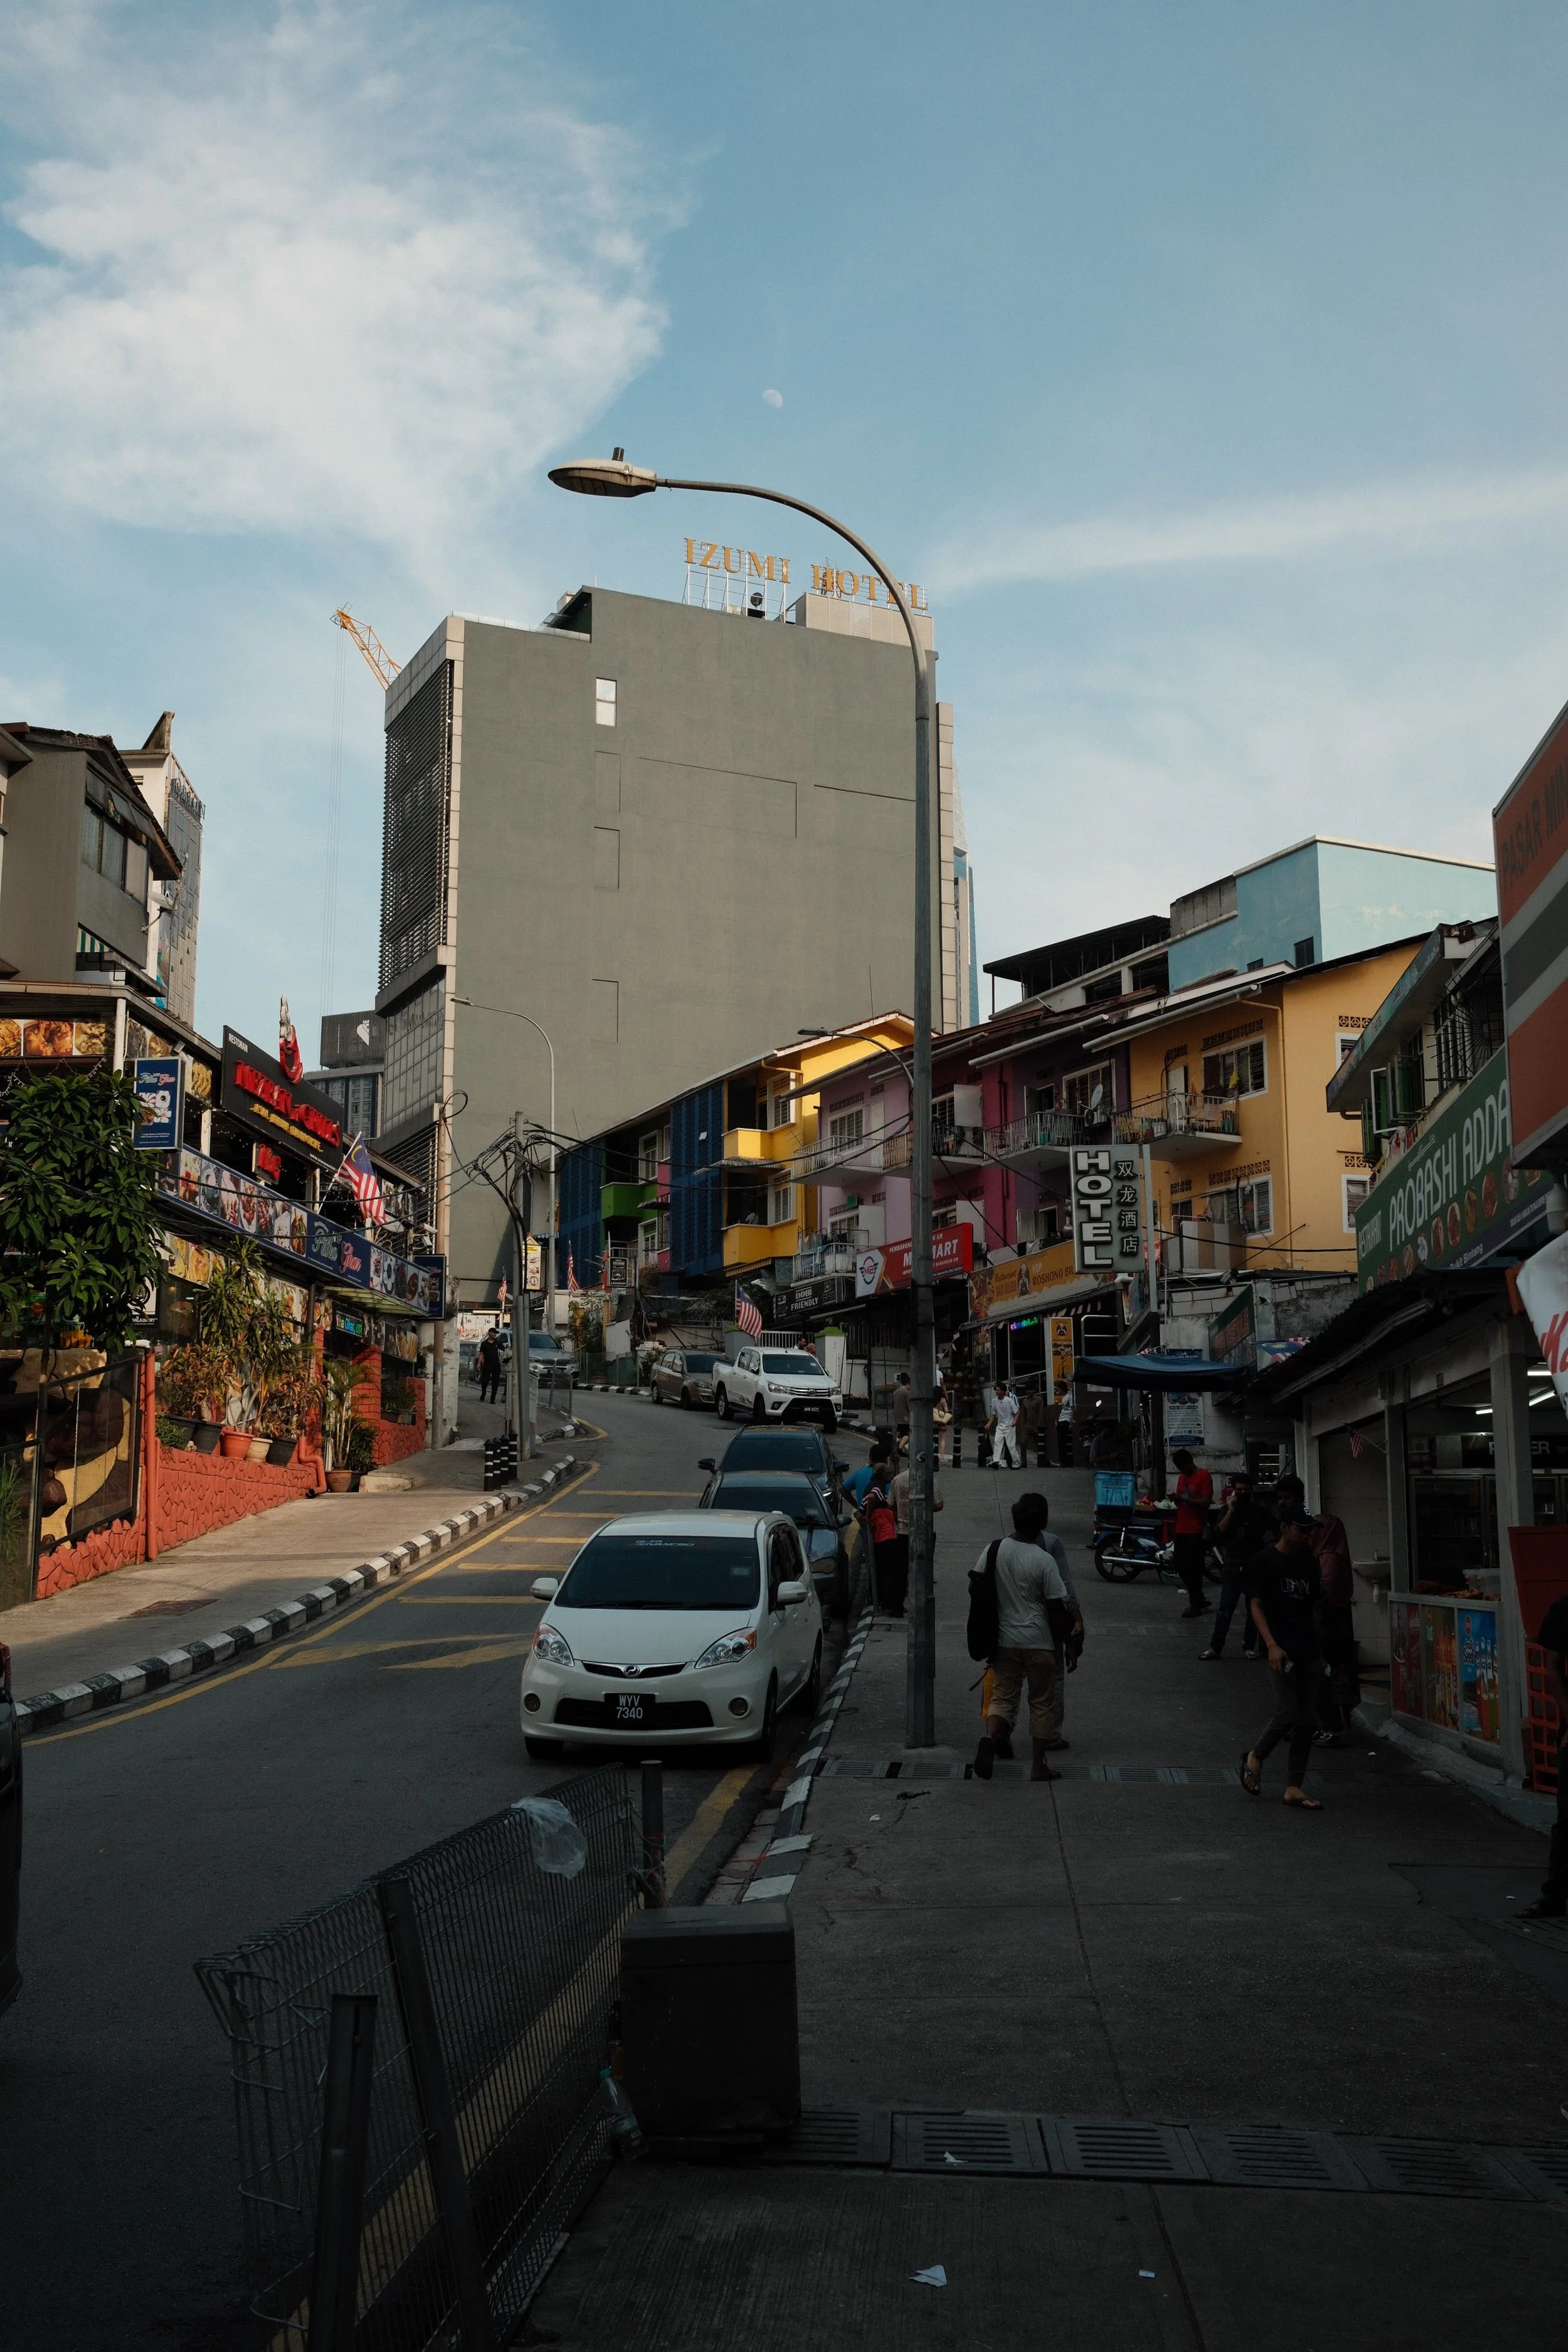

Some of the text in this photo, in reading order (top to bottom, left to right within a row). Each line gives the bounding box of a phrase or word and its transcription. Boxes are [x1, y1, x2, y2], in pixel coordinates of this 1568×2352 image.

[684, 537, 791, 584] IZUMI
[228, 1032, 248, 1054] RESTORAN
[1389, 1131, 1457, 1253] PROBASHI
[1462, 1078, 1510, 1187] ADDA
[1076, 1150, 1113, 1266] HOTEL
[1116, 1160, 1140, 1254] 双龙酒店
[1463, 1243, 1483, 1264] Bintang
[1032, 1264, 1075, 1286] ROSHONA BIL
[791, 1296, 819, 1311] FRIENDLY
[619, 1695, 640, 1707] WYV
[616, 1707, 644, 1719] 7340
